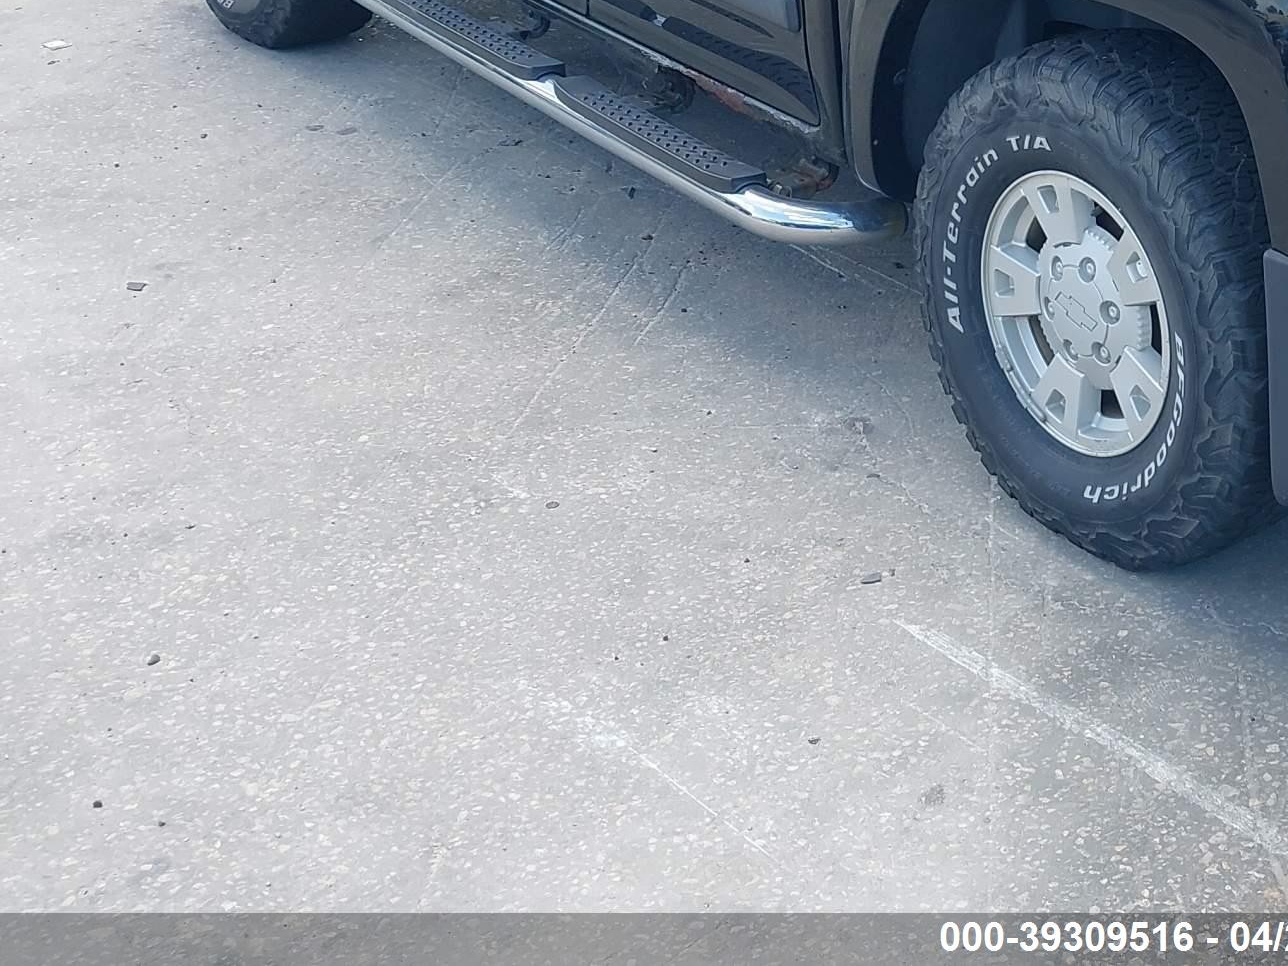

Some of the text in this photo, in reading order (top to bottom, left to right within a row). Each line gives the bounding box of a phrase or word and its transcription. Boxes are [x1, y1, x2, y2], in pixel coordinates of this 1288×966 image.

[943, 134, 1052, 334] All-Terrain T/A
[1083, 331, 1185, 504] BFGoodrich
